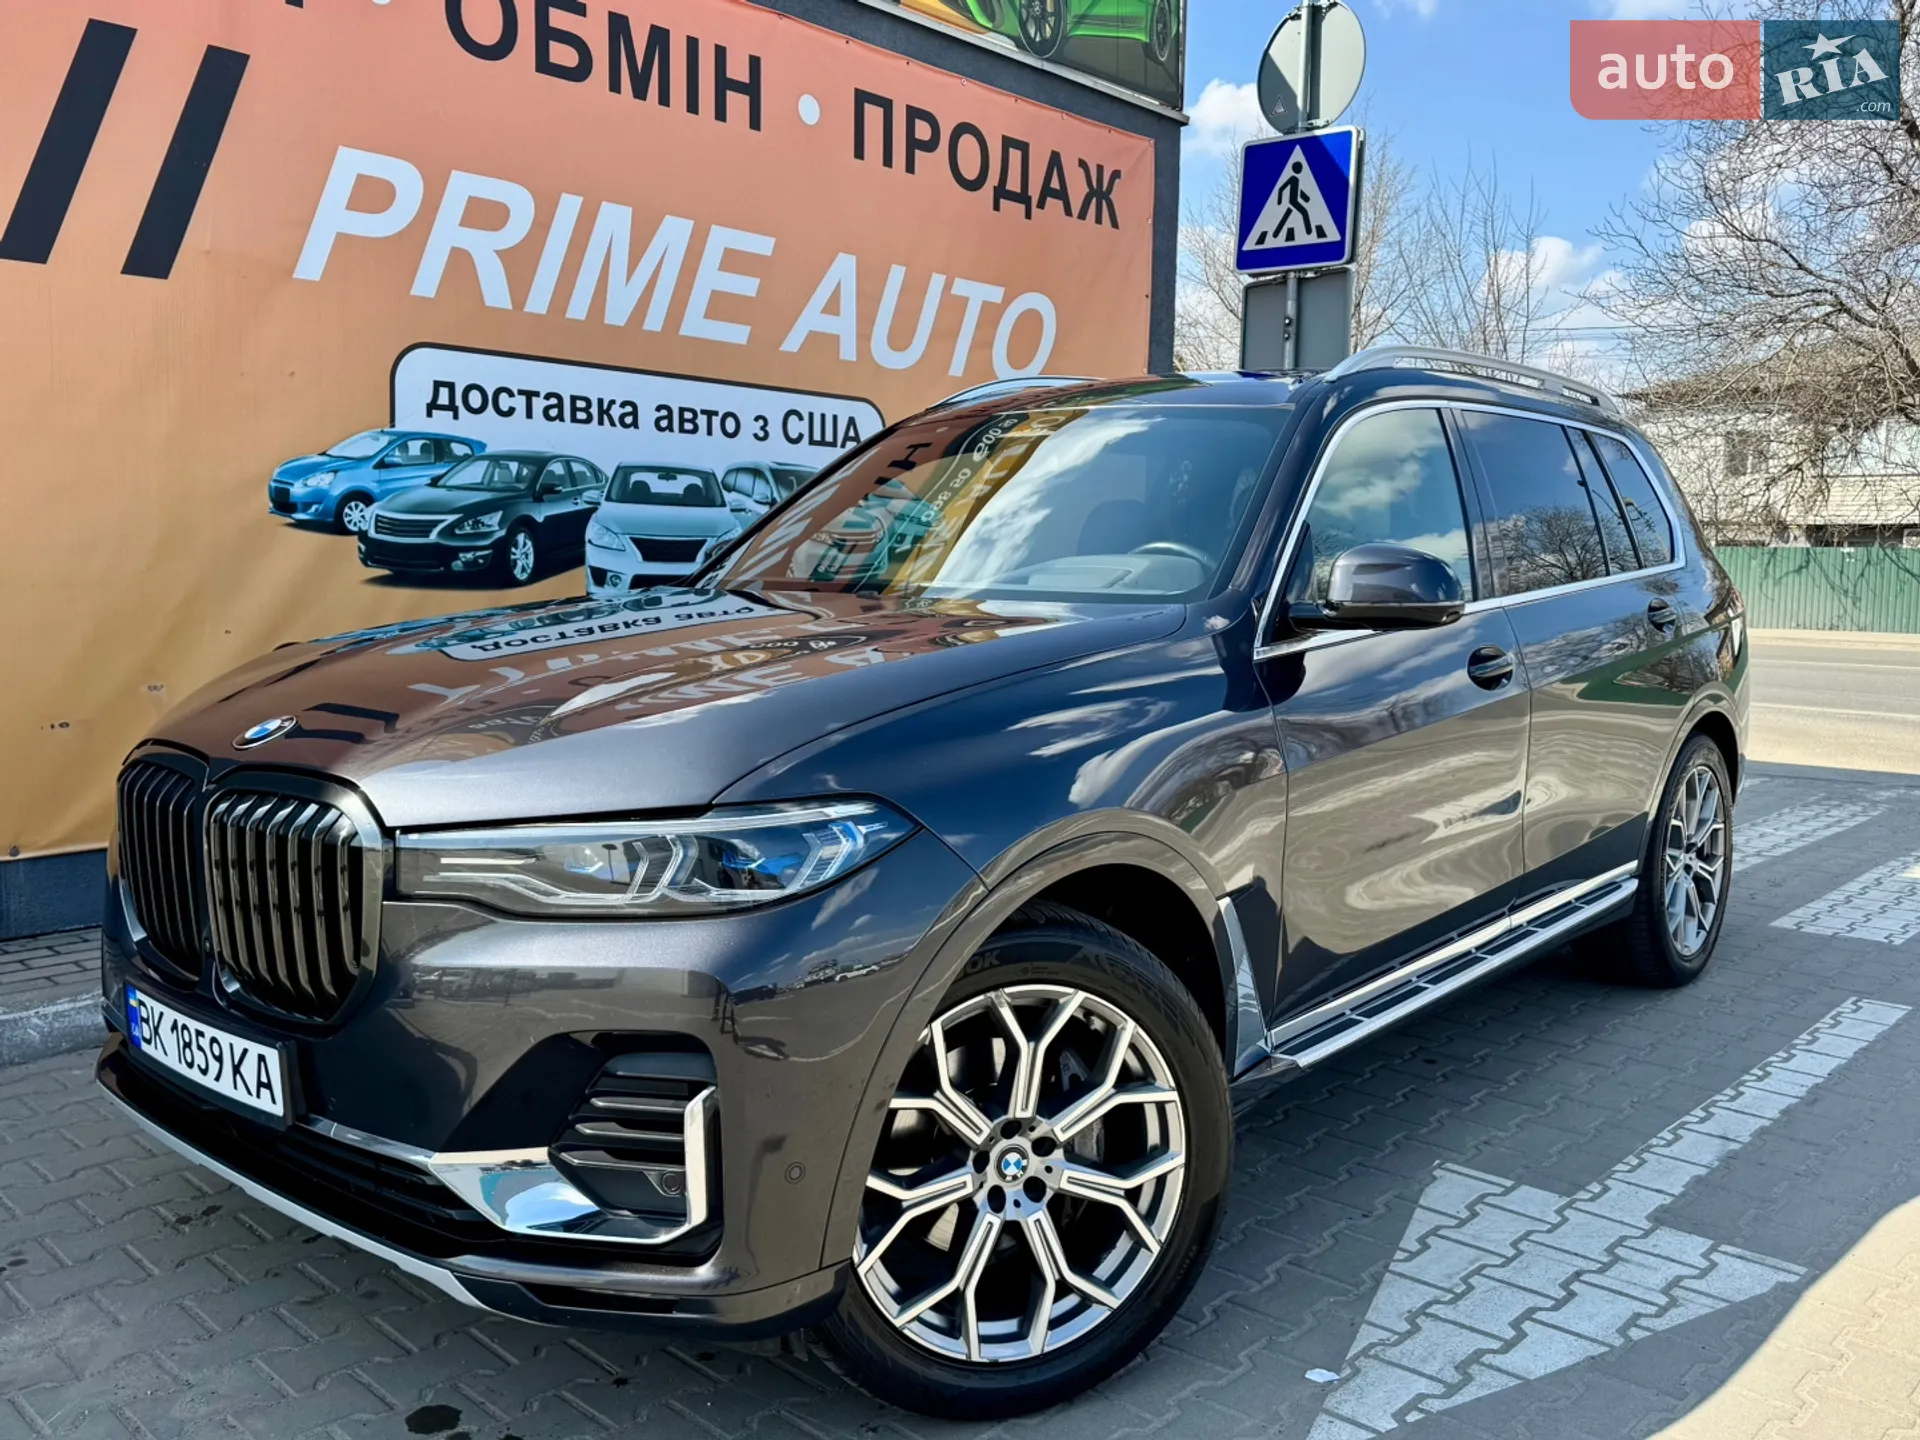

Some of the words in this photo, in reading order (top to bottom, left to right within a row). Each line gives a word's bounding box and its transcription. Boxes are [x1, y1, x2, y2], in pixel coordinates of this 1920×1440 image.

[445, 0, 761, 132] ОБМІН
[853, 87, 1122, 230] ПРОДАЖ
[292, 145, 776, 345] PRIME
[780, 252, 1057, 379] AUTO
[426, 380, 639, 430] доставка
[653, 403, 742, 438] авто
[752, 414, 770, 442] з
[781, 409, 862, 450] США
[138, 998, 168, 1058] BK
[170, 1018, 224, 1083] 1859
[230, 1042, 278, 1106] KA
